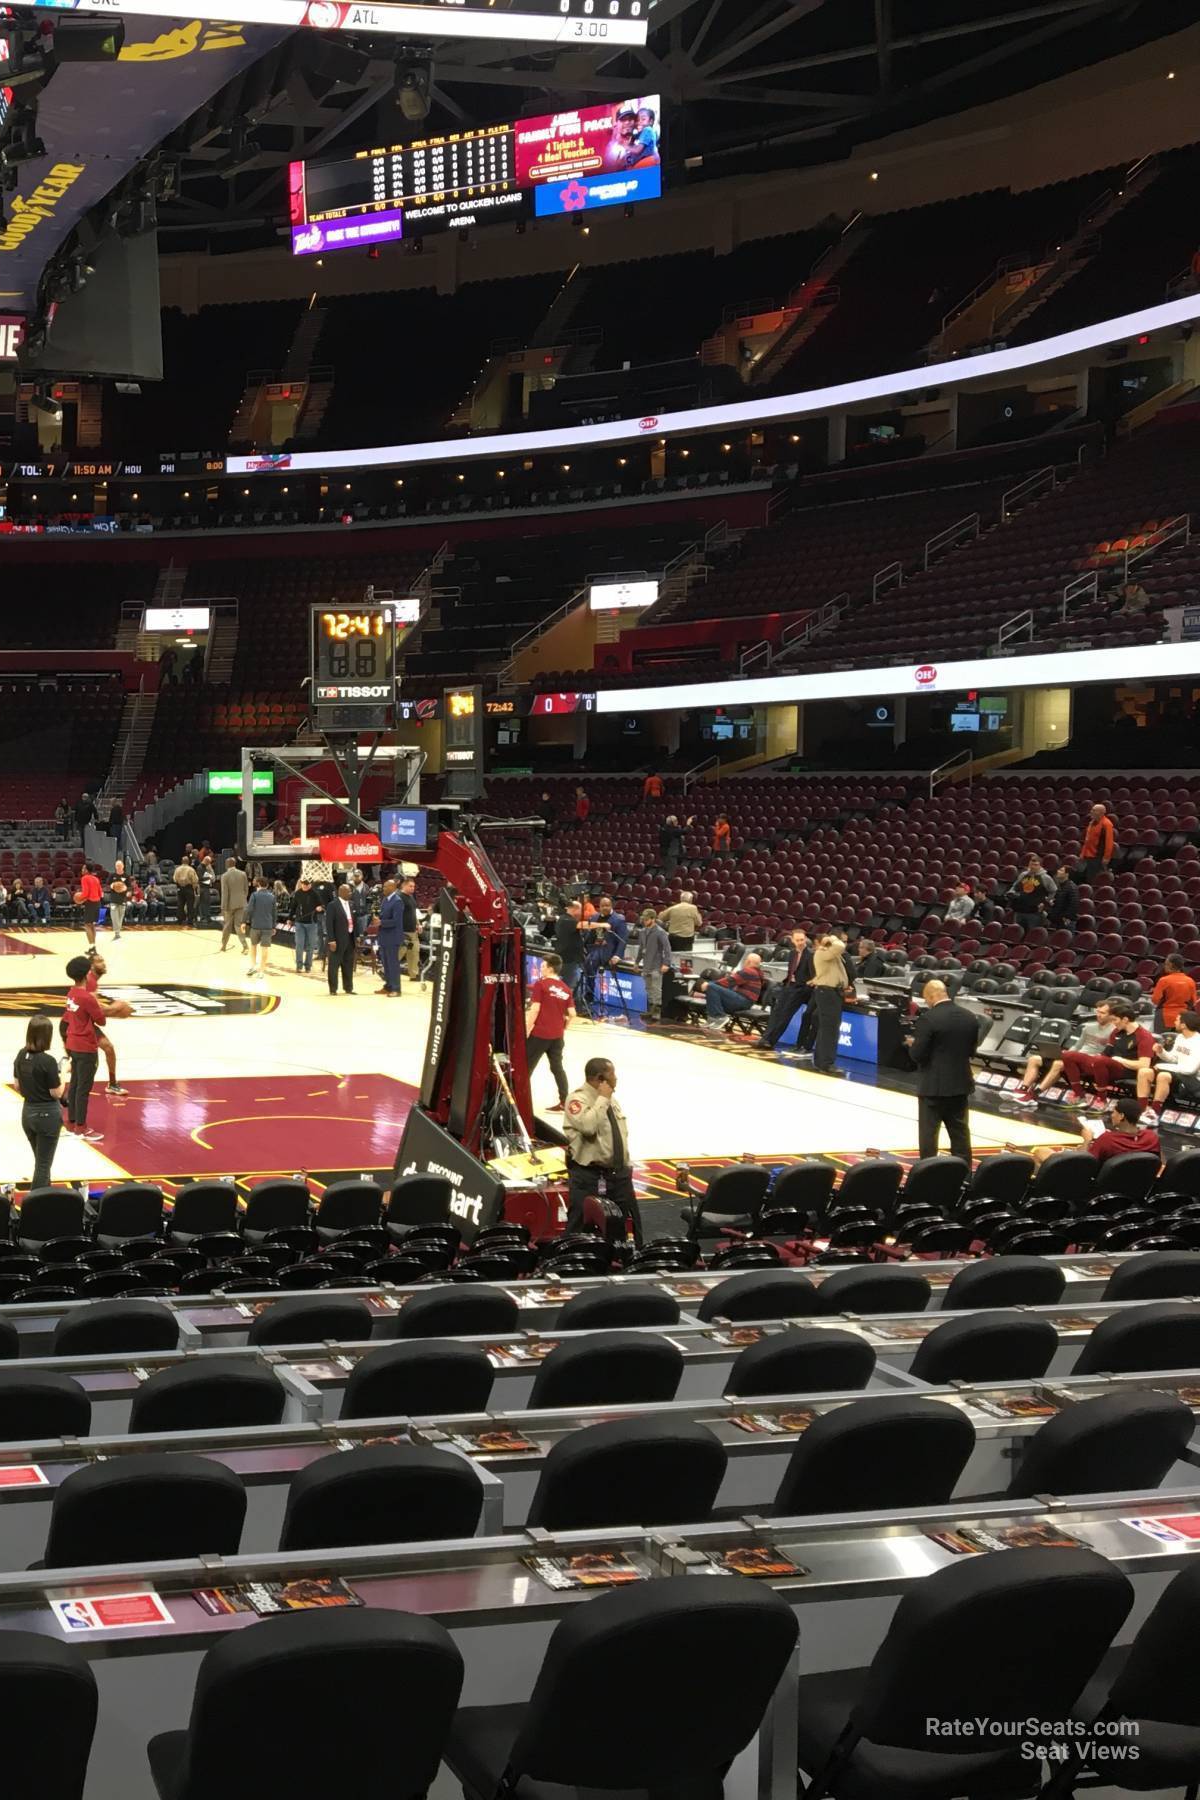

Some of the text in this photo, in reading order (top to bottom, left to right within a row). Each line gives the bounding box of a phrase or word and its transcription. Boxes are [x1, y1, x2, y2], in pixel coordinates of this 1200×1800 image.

[353, 9, 378, 25] ATL
[405, 192, 522, 220] WELCOME TO QUICKEN LOANS
[449, 216, 476, 227] ARENA
[20, 464, 55, 476] TOL: 7
[74, 464, 112, 475] 11:50 AM
[124, 464, 175, 474] HOU PHI
[206, 462, 224, 470] 8:00
[324, 614, 384, 638] 72:41
[338, 686, 390, 698] TISSOT
[486, 702, 514, 712] 72:42
[544, 698, 552, 712] 0
[586, 700, 592, 710] 0
[403, 708, 410, 718] 0
[467, 857, 488, 896] SPALDING
[431, 950, 450, 1065] Cleveland Clinic
[428, 1161, 464, 1186] DISCOUNT
[450, 1189, 483, 1226] art
